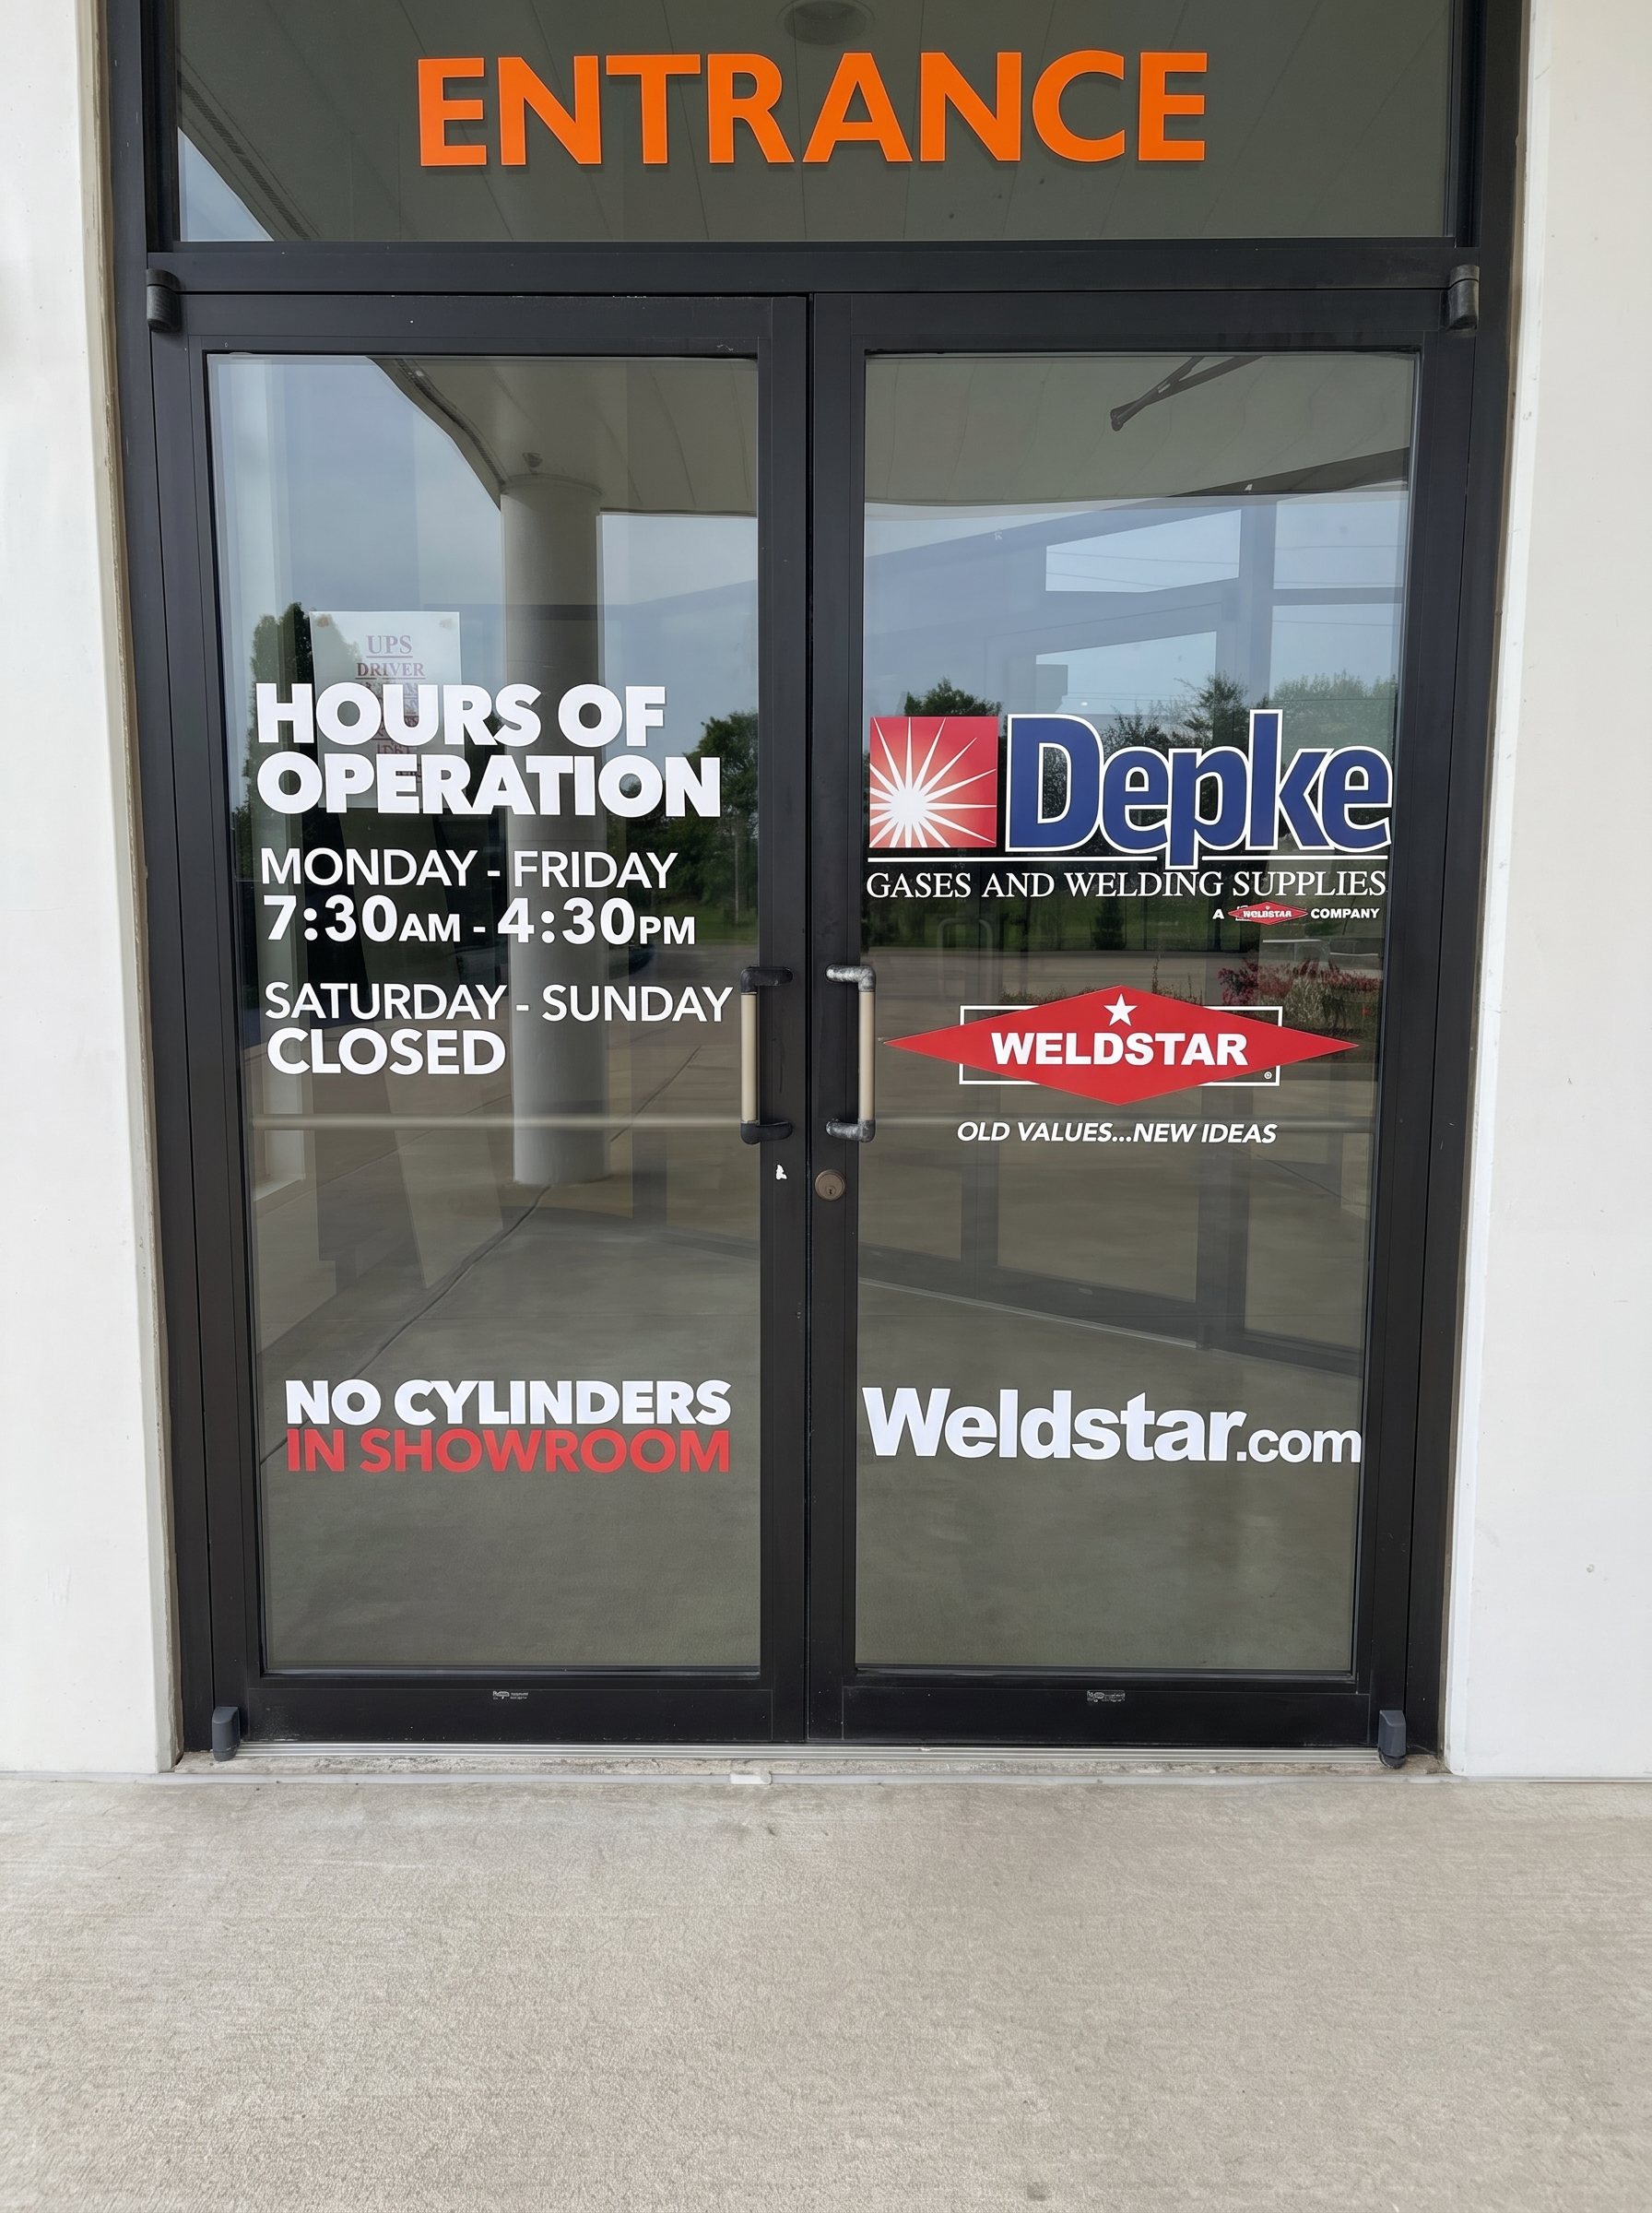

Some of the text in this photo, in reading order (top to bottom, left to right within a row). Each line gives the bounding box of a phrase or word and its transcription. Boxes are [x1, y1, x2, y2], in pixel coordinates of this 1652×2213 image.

[418, 50, 1208, 166] ENTRANCE
[366, 635, 412, 655] UPS
[357, 662, 426, 677] DRIVER
[256, 682, 667, 748] HOURS OF
[256, 751, 721, 818] OPERATION
[1005, 709, 1393, 870] Depke
[261, 847, 478, 885] MONDAY
[513, 850, 678, 889] FRIDAY
[866, 870, 1386, 898] GASES AND WELDING SUPPLIES
[1212, 908, 1224, 919] A
[1310, 908, 1380, 919] COMPANY
[265, 981, 507, 1020] SATURDAY
[542, 985, 733, 1023] SUNDAY
[267, 1027, 506, 1075] CLOSED
[991, 1032, 1248, 1067] WELDSTAR
[957, 1121, 1009, 1142] OLD
[1201, 1123, 1279, 1143] IDEAS
[285, 1379, 731, 1426] NO CYLINDERS
[862, 1387, 1362, 1463] Weldstar.com
[287, 1428, 730, 1473] IN SHOWROOM
